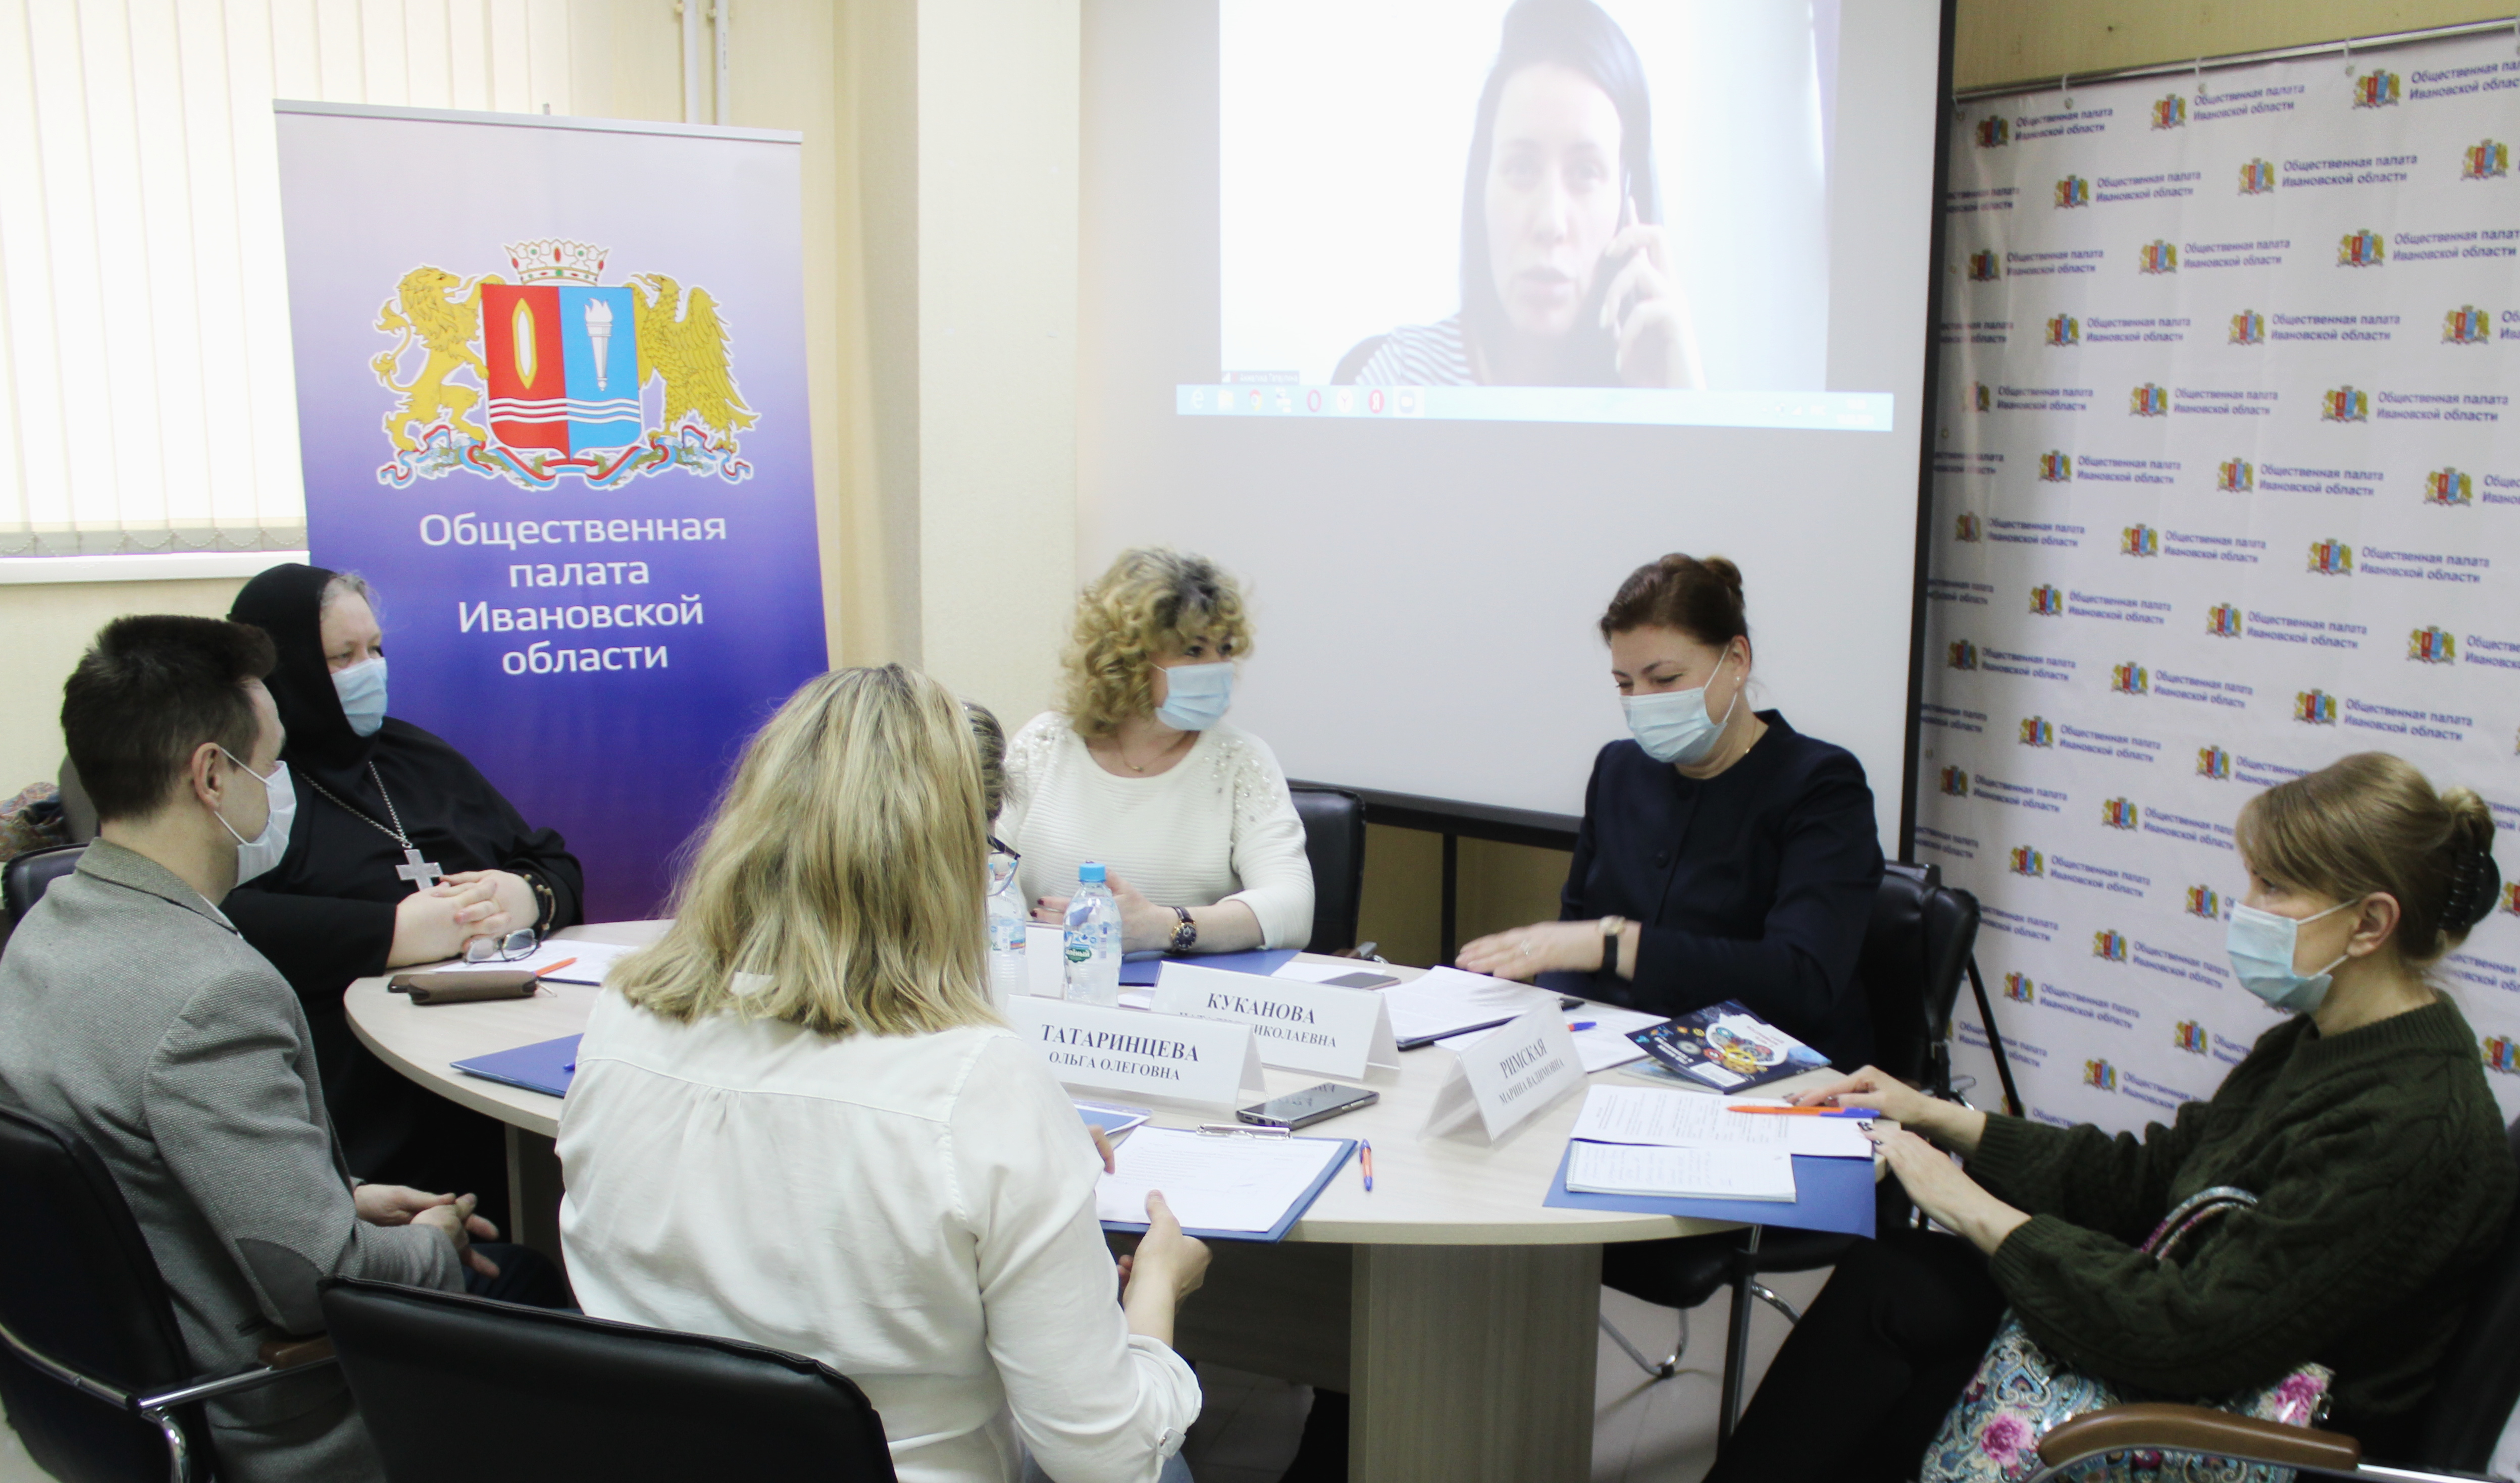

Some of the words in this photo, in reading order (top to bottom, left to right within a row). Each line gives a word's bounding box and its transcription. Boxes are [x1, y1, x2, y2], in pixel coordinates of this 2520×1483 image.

[2411, 64, 2498, 84] Общественная
[2194, 89, 2262, 107] Общественная
[2266, 85, 2304, 96] палата
[2409, 81, 2479, 100] Ивановской
[2483, 78, 2520, 91] облас
[2193, 105, 2248, 121] Ивановской
[2251, 102, 2294, 114] области
[2283, 158, 2372, 172] Общественная
[2376, 155, 2418, 166] палата
[2097, 175, 2165, 188] Общественная
[2168, 172, 2201, 182] палата
[2282, 173, 2353, 187] Ивановской
[2357, 172, 2407, 184] области
[2095, 190, 2150, 202] Ивановской
[2153, 187, 2193, 198] области
[2185, 242, 2253, 254] Общественная
[2256, 240, 2290, 250] палата
[2394, 231, 2477, 245] Общественная
[2481, 230, 2520, 240] палат
[2184, 256, 2240, 268] Ивановской
[2243, 255, 2282, 266] области
[2393, 247, 2458, 261] Ивановской
[2462, 245, 2516, 258] области
[2087, 318, 2155, 329] Общественная
[2158, 319, 2190, 327] палата
[2273, 314, 2356, 326] Общественная
[2360, 315, 2400, 325] палата
[2086, 333, 2140, 342] Ивановской
[2143, 332, 2183, 342] области
[2271, 330, 2337, 341] Ивановской
[2341, 329, 2390, 341] области
[2175, 388, 2243, 399] Общественная
[2246, 392, 2278, 400] палата
[2378, 392, 2459, 404] Общественная
[2463, 395, 2508, 405] палата
[2174, 404, 2229, 414] Ивановской
[2232, 404, 2270, 415] области
[2377, 408, 2440, 419] Ивановской
[2444, 409, 2498, 421] области
[2078, 455, 2146, 468] Общественная
[2150, 461, 2181, 470] палата
[2260, 464, 2340, 479] Общественная
[2344, 470, 2384, 481] палата
[2077, 470, 2131, 482] Ивановской
[2134, 473, 2174, 484] области
[2259, 480, 2322, 493] Ивановской
[2326, 483, 2374, 496] области
[420, 512, 726, 550] Общественная
[2165, 531, 2232, 546] Общественная
[2235, 539, 2266, 549] палата
[2164, 546, 2218, 559] Ивановской
[2221, 551, 2258, 563] области
[2362, 546, 2442, 564] Общественная
[2446, 556, 2489, 568] палата
[509, 560, 649, 588] палата
[2360, 563, 2423, 578] Ивановской
[2427, 568, 2480, 583] области
[2069, 591, 2138, 607] Общественная
[2141, 601, 2171, 611] палата
[458, 594, 703, 633] Ивановской
[2068, 606, 2122, 620] Ивановской
[2125, 612, 2164, 624] области
[2248, 611, 2325, 630] Общественная
[2329, 622, 2367, 634] палата
[2247, 627, 2307, 643] Ивановской
[2311, 635, 2357, 649] области
[2466, 634, 2520, 652] Обществе
[501, 640, 668, 675] области
[2465, 652, 2520, 669] Ивановск
[2155, 670, 2222, 690] Общественная
[2225, 683, 2253, 696] палата
[2154, 685, 2207, 702] Ивановской
[2210, 694, 2245, 708] области
[2345, 698, 2426, 720] Общественная
[2430, 713, 2473, 727] палата
[2061, 724, 2128, 744] Общественная
[2132, 738, 2161, 750] палата
[2344, 714, 2407, 734] Ивановской
[2410, 725, 2462, 741] области
[2059, 738, 2113, 756] Ивановской
[2116, 749, 2153, 762] области
[2144, 807, 2211, 830] Общественная
[2143, 821, 2197, 841] Ивановской
[2199, 834, 2234, 850] области
[2051, 855, 2119, 878] Общественная
[2122, 872, 2150, 886] палата
[2050, 869, 2103, 888] Ивановской
[2106, 882, 2143, 897] области
[2027, 916, 2059, 930] палата
[2014, 926, 2051, 941] области
[2134, 941, 2200, 967] Общественная
[2203, 962, 2229, 978] палата
[2132, 955, 2186, 978] Ивановской
[2189, 972, 2223, 989] области
[1206, 992, 1316, 1025] КУКАНОВА
[2041, 983, 2109, 1009] Общественная
[2112, 1003, 2140, 1019] палата
[2039, 996, 2094, 1018] Ивановской
[2097, 1013, 2132, 1029] области
[1041, 1024, 1199, 1062] ТАТАРИНЦЕВА
[1253, 1024, 1337, 1047] ИКОЛАЕВНА
[1500, 1038, 1547, 1079] РИМСКАЯ
[2020, 1041, 2048, 1057] палата
[1049, 1051, 1096, 1068] ОЛЬГА
[1100, 1058, 1180, 1080] ОЛЕГОВНА
[2009, 1051, 2040, 1068] области
[1499, 1080, 1528, 1104] МАРИНА
[1526, 1057, 1564, 1088] ВАДИМОВНА
[2124, 1072, 2190, 1100] Общественная
[2123, 1085, 2176, 1110] Ивановской
